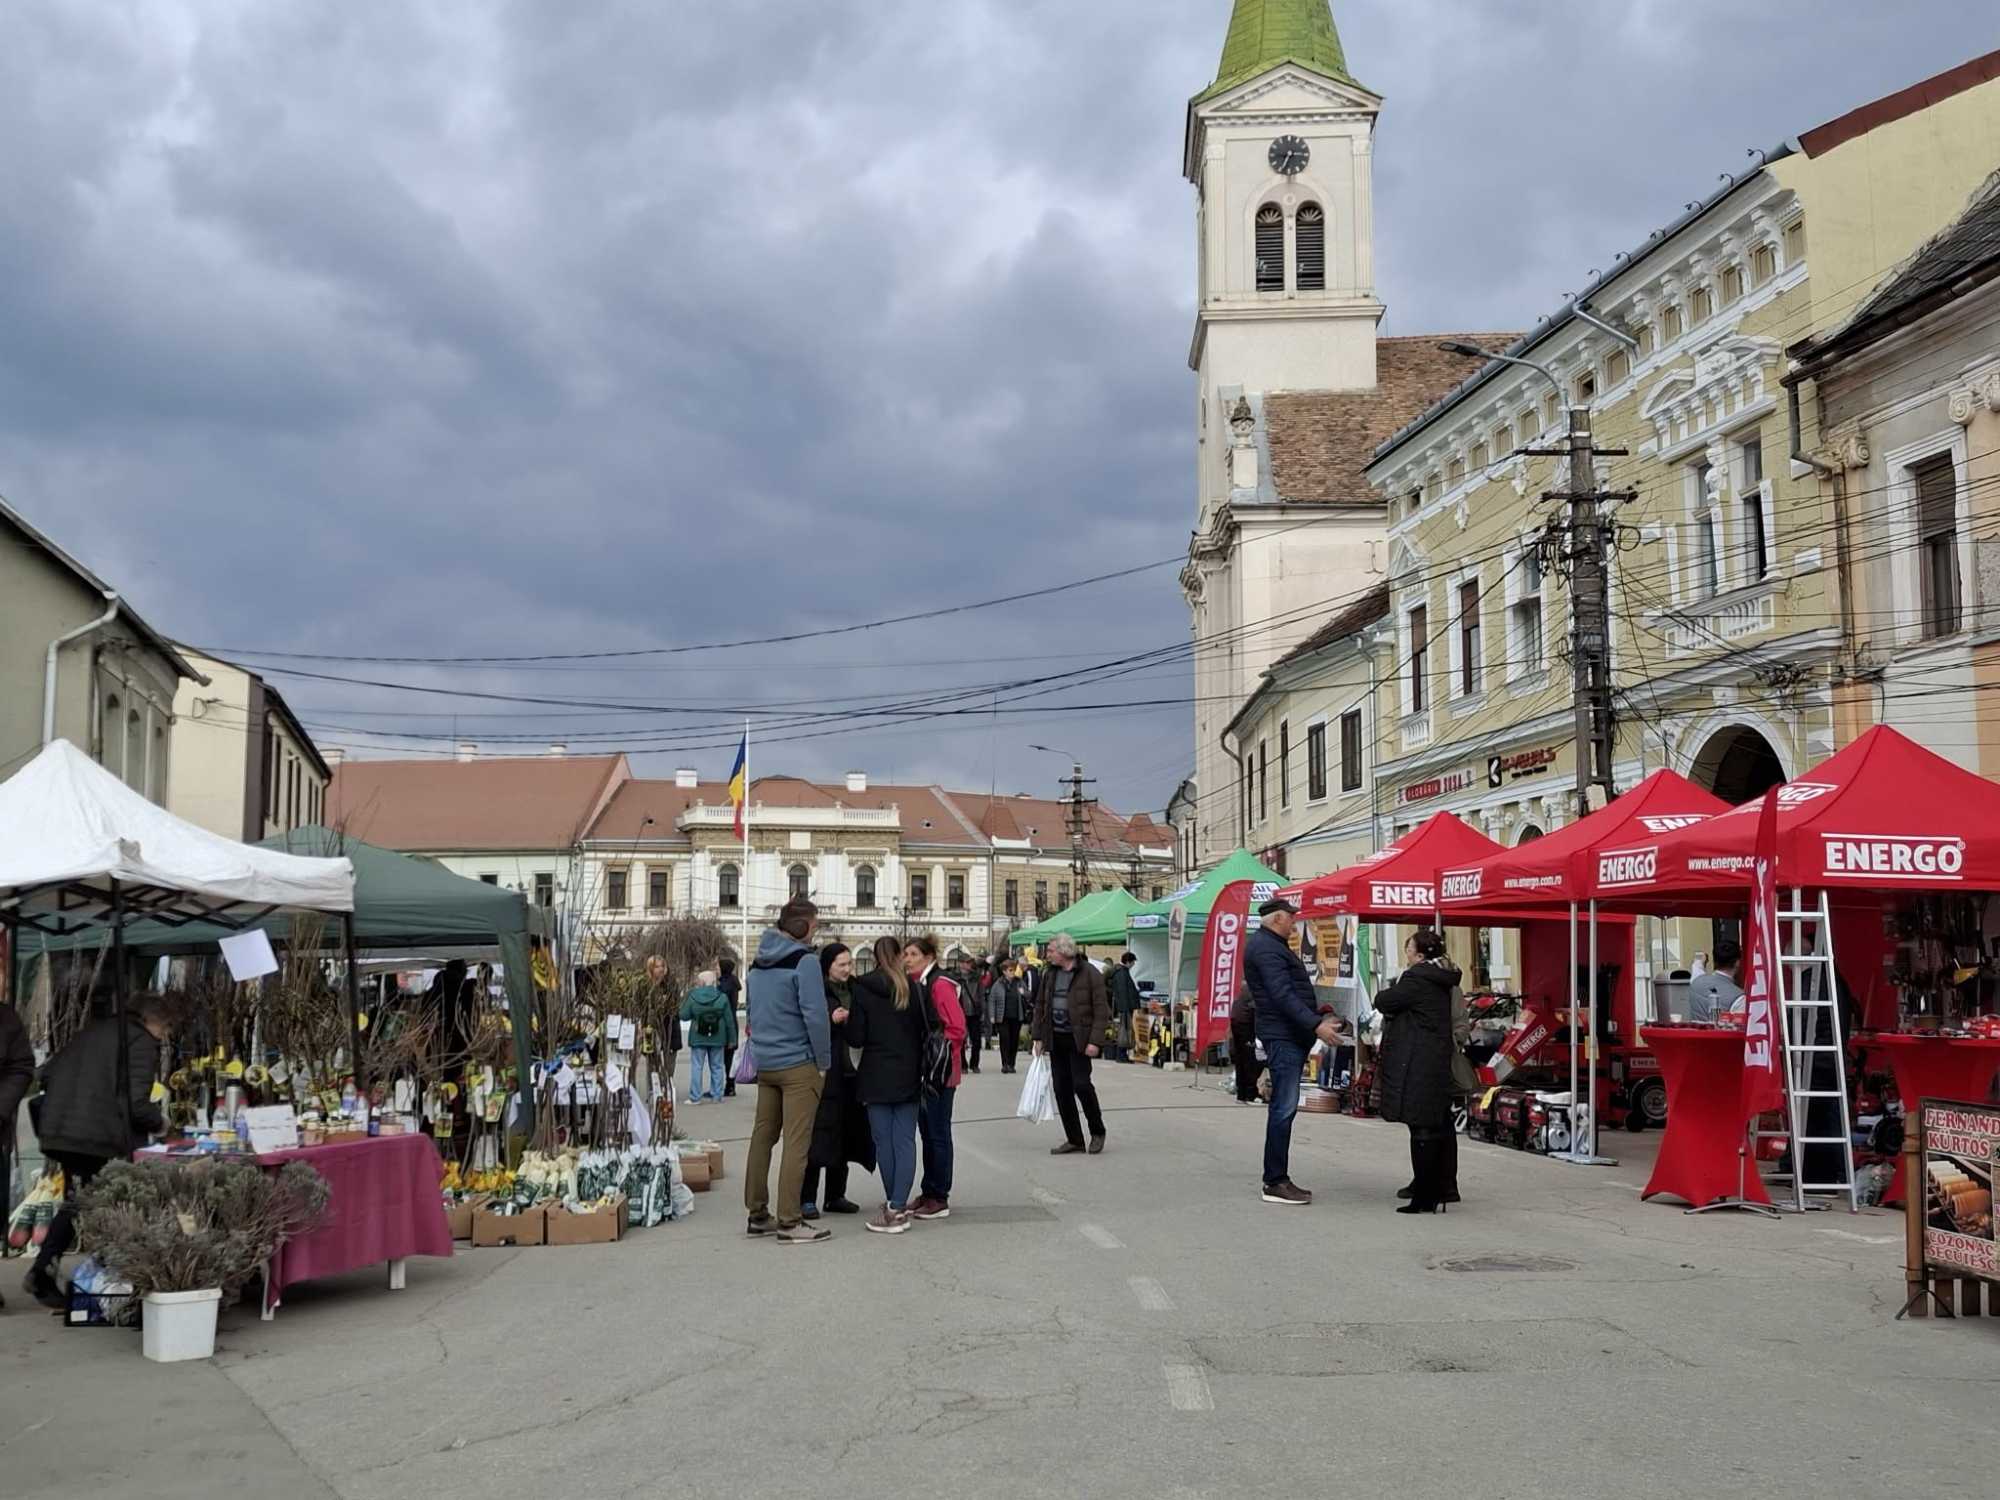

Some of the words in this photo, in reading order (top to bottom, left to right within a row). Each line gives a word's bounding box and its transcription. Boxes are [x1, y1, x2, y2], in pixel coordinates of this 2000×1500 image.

[1599, 852, 1657, 882] ENERGO
[1825, 841, 1963, 873] ENERGO
[1371, 886, 1435, 904] ENER
[1441, 874, 1482, 897] ENERGO
[1212, 913, 1239, 1018] ENERGO
[1928, 1231, 1994, 1257] COZONAC
[1927, 1246, 1996, 1271] SECUIESC
